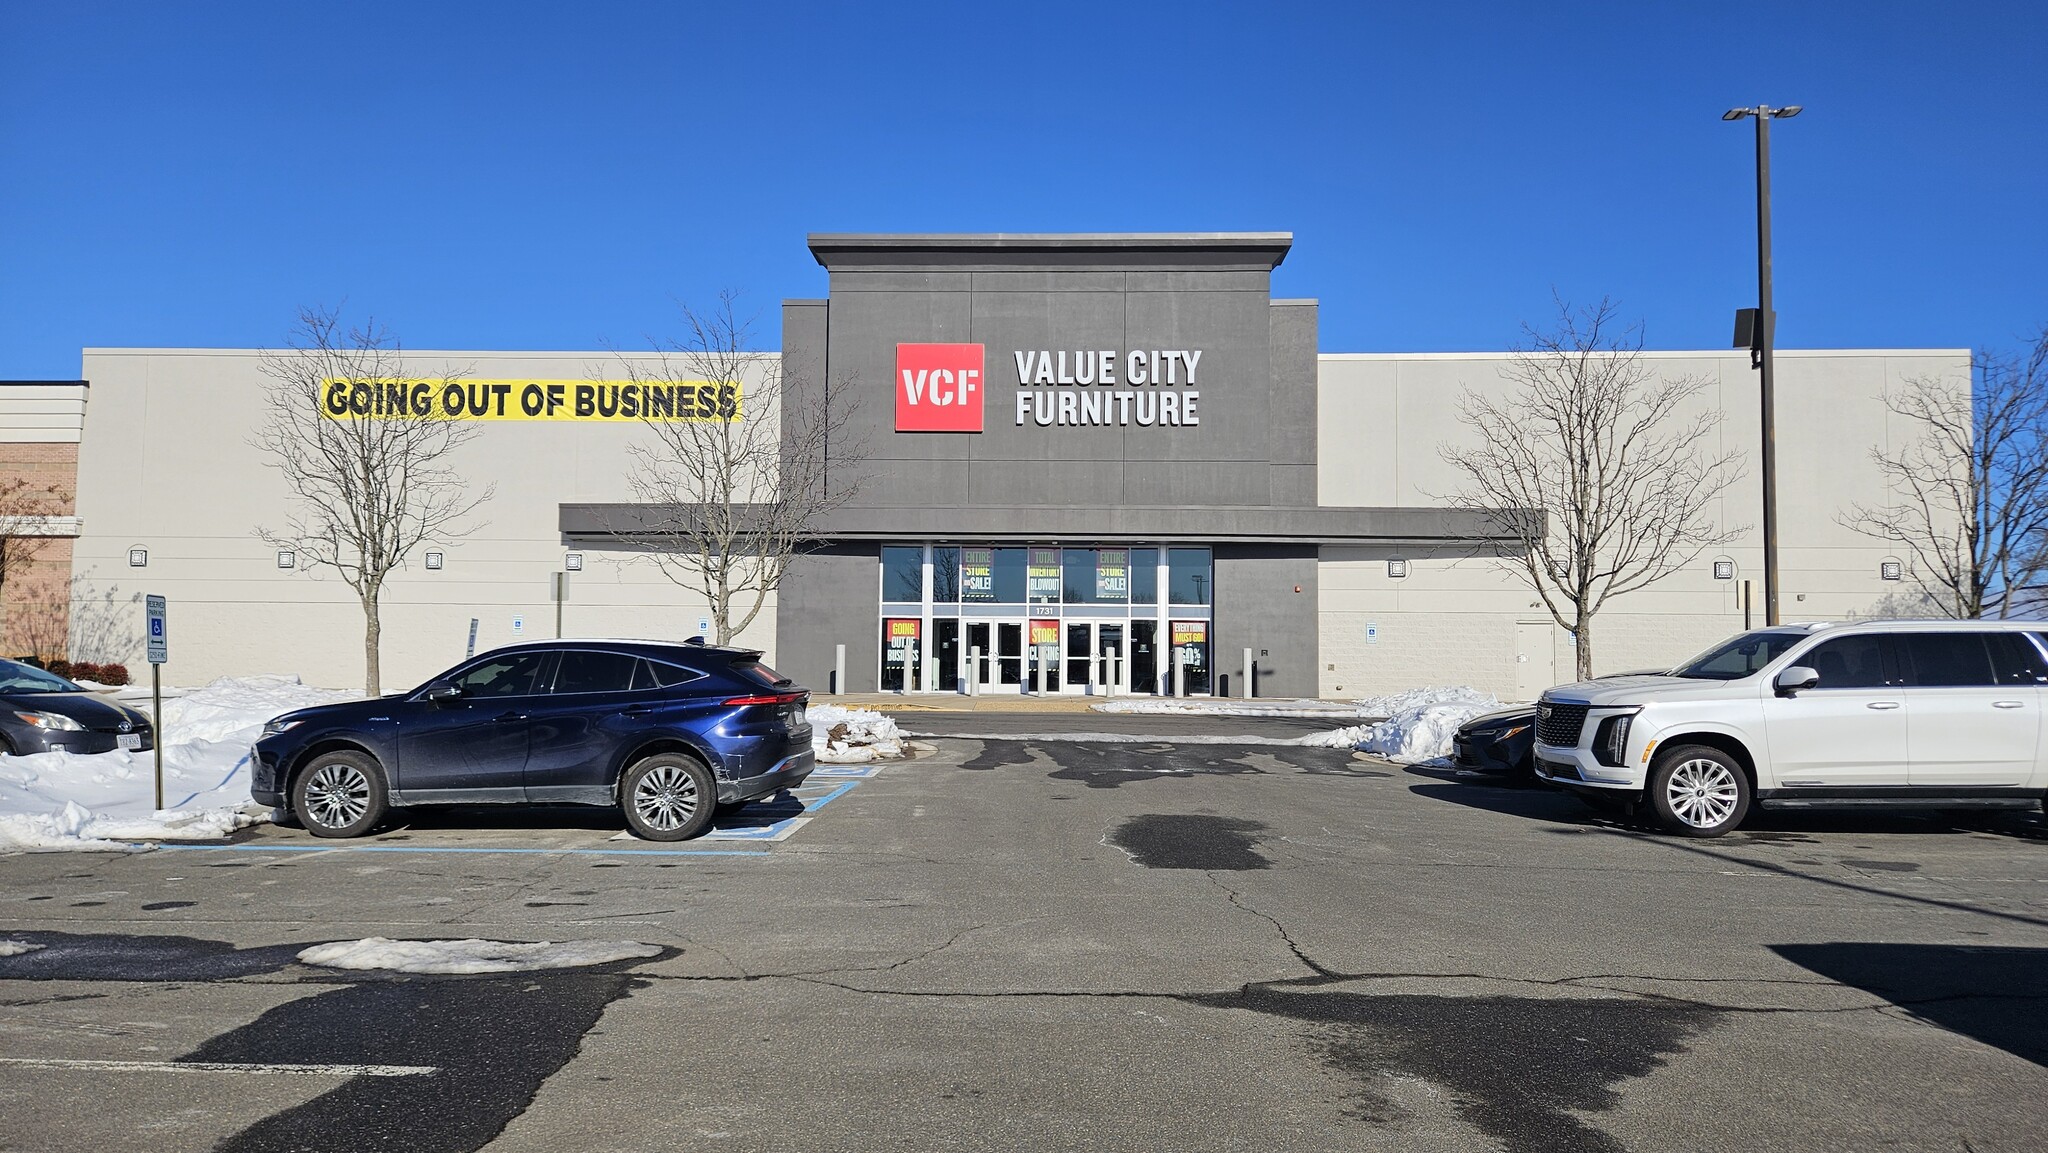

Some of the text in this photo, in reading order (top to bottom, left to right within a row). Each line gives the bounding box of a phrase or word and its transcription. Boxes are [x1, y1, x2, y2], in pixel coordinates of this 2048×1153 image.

[1014, 349, 1202, 386] VALUE CITY
[902, 368, 979, 406] VCF
[326, 382, 737, 418] GOING OUT OF BUSINESS
[1015, 391, 1201, 426] FURNITURE
[965, 551, 991, 563] ENTIRE
[1035, 551, 1056, 564] TOTAL
[1100, 552, 1126, 564] ENTIRE
[966, 564, 990, 576] STORE
[1100, 565, 1125, 577] STORE
[970, 577, 991, 590] SALE!
[1030, 578, 1059, 591] BLOWOUT
[1105, 577, 1126, 591] SALE!
[149, 609, 164, 617] PARKING
[1036, 607, 1053, 615] 1731
[892, 622, 915, 635] GOING
[1174, 623, 1205, 633] EVERYTHING
[1031, 628, 1058, 643] STORE
[1175, 633, 1204, 643] MUST GO!
[891, 636, 905, 649] OUT
[1029, 645, 1060, 661] CLING
